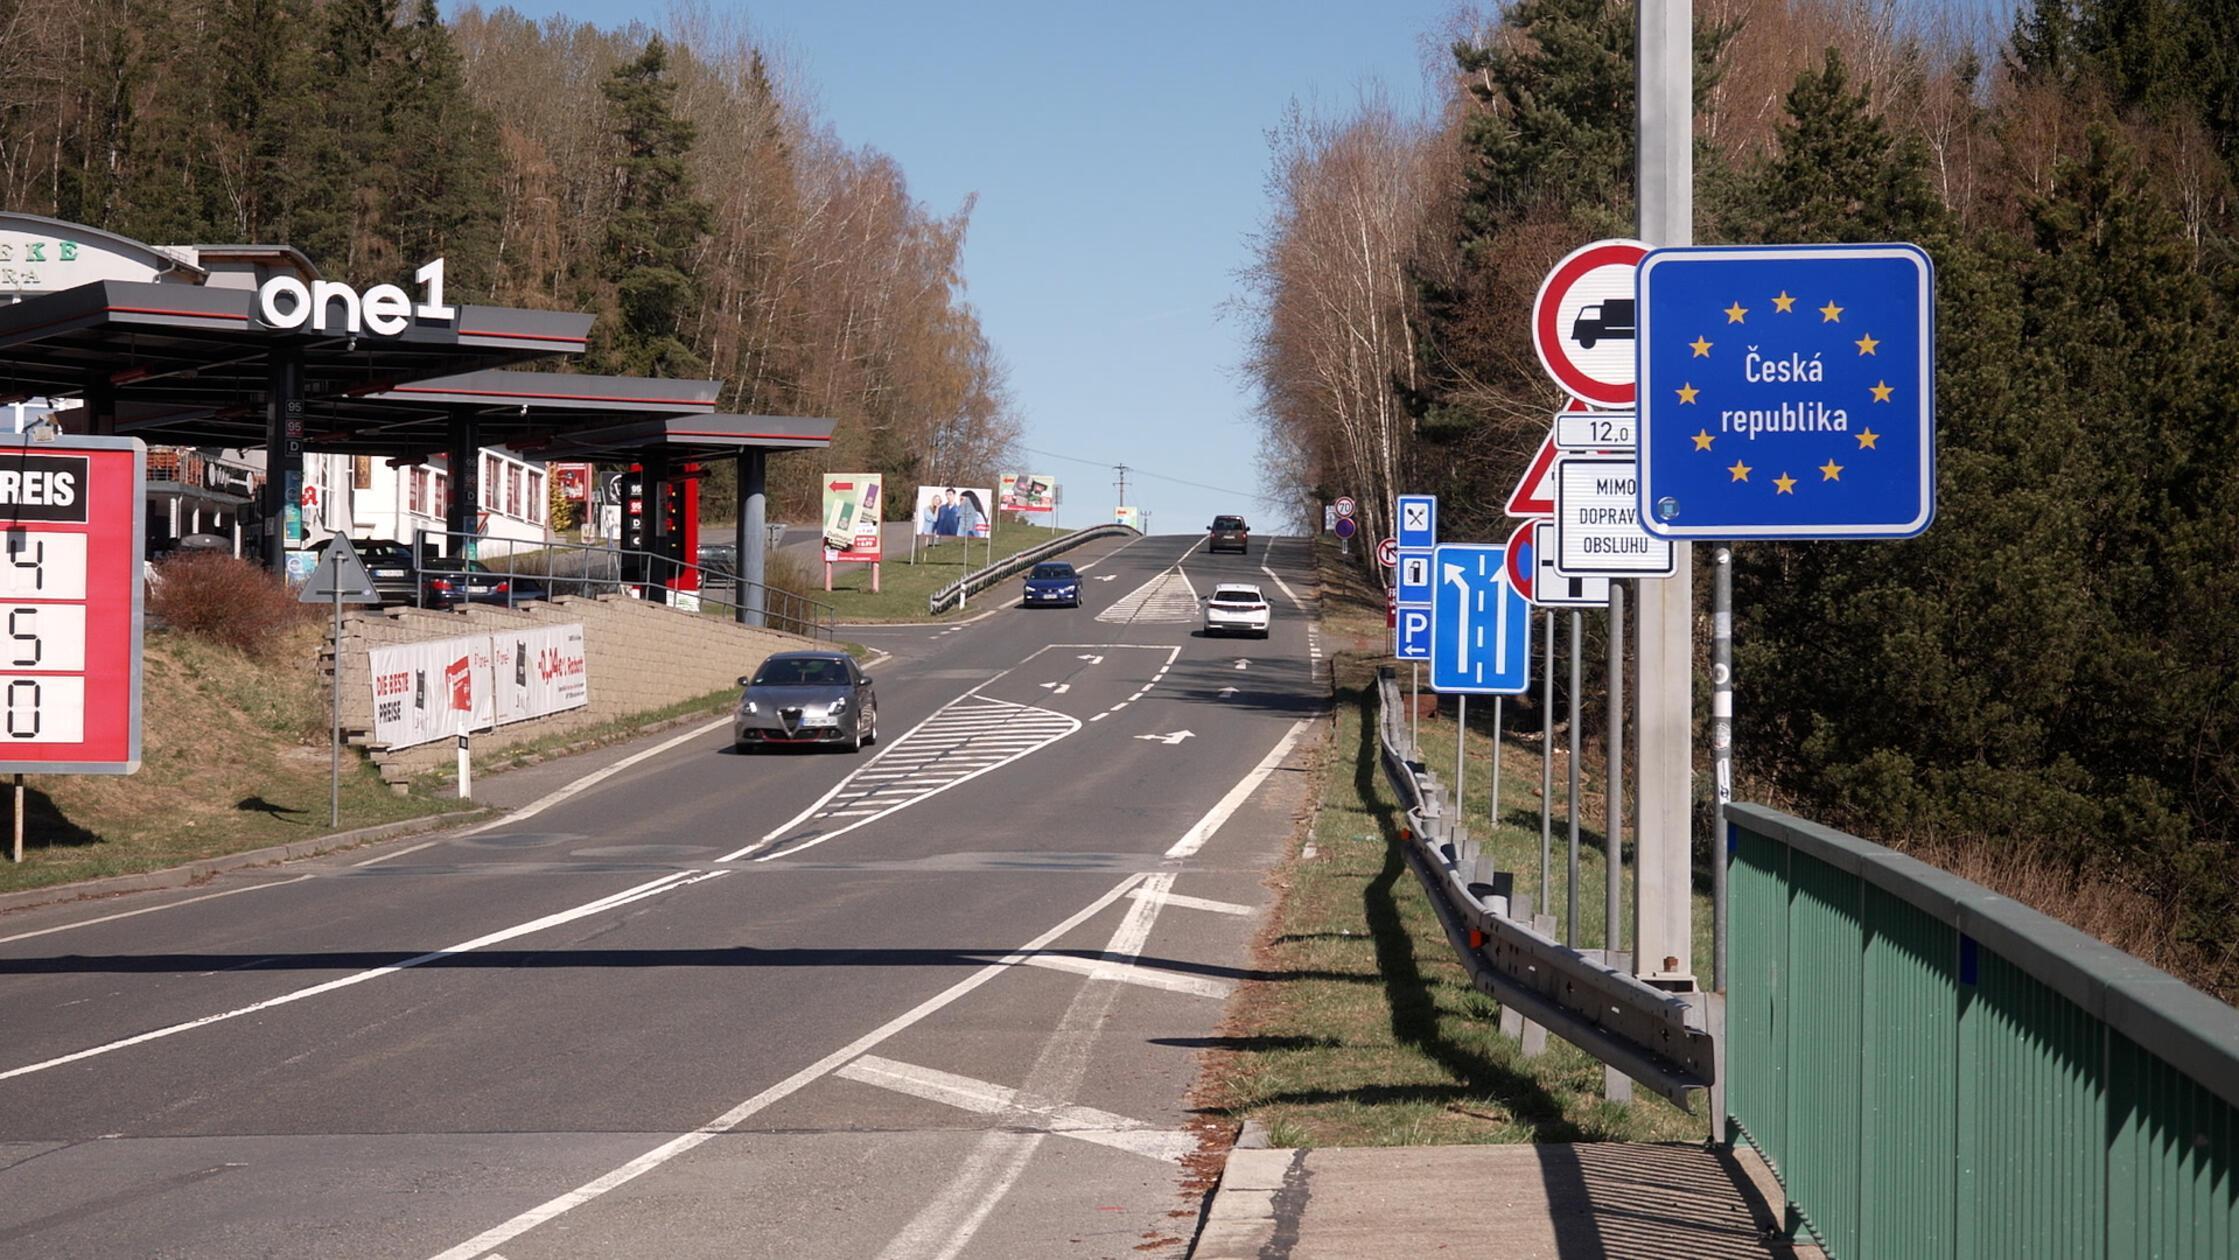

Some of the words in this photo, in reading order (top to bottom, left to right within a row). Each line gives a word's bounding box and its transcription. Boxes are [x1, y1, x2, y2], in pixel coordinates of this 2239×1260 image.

[1745, 345, 1824, 383] Česká
[288, 402, 302, 413] 95
[1590, 421, 1629, 443] 12,0
[1721, 402, 1848, 440] republika
[1597, 479, 1637, 495] MIMO
[1339, 502, 1351, 513] 70
[1580, 508, 1639, 525] DOPRAV
[1583, 537, 1649, 554] OBSLUHU
[10, 540, 43, 591] 4
[9, 608, 41, 666] 5
[1406, 613, 1428, 643] P
[7, 680, 41, 738] 0
